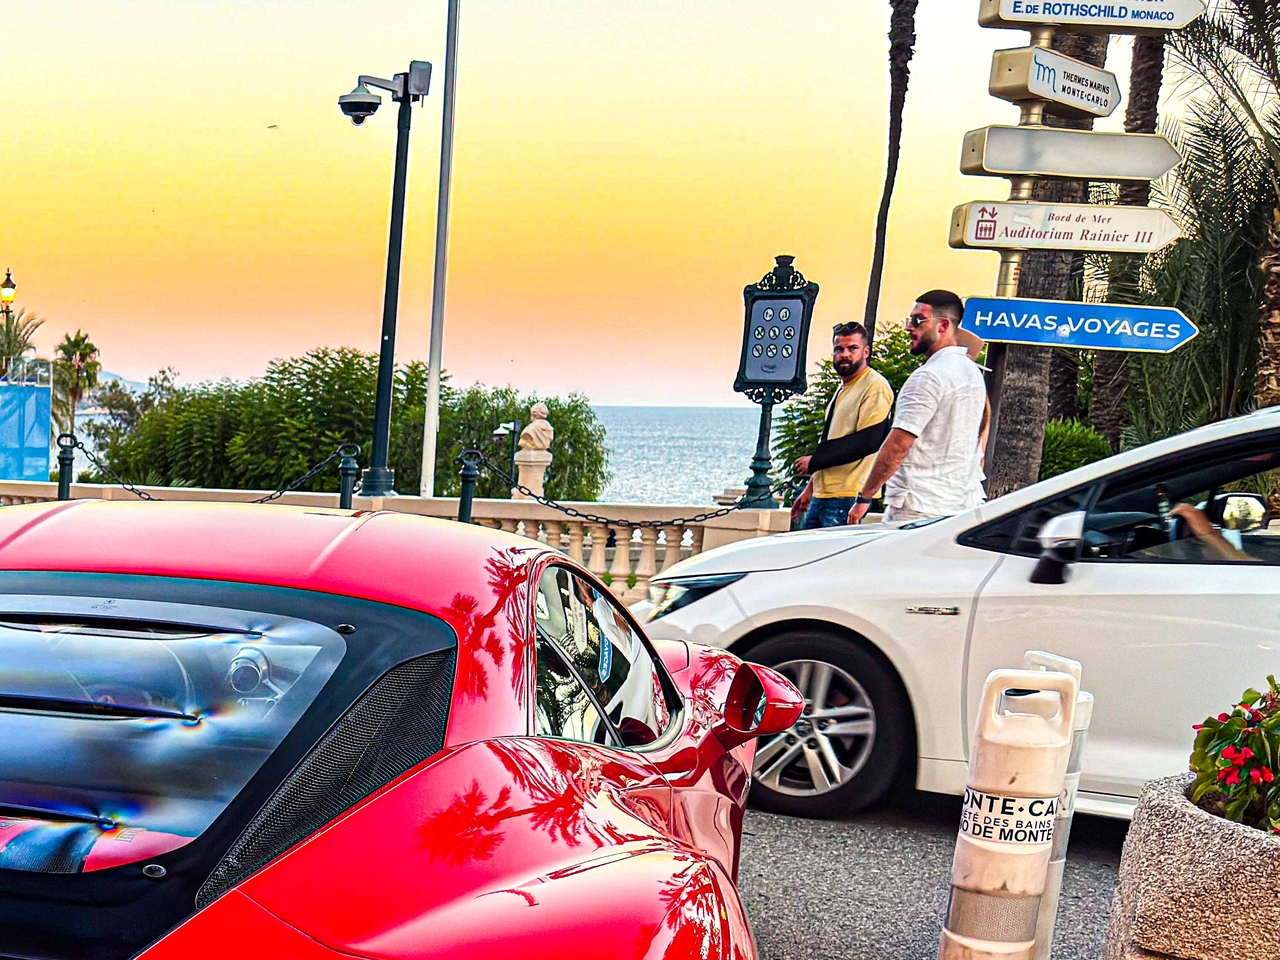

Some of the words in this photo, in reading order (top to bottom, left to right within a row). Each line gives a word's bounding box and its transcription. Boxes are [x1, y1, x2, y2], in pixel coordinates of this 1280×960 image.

[1025, 4, 1039, 14] DE
[1042, 3, 1128, 19] ROTHSCHILD
[1131, 10, 1175, 21] MONACO
[1063, 71, 1089, 88] THERMES
[1089, 81, 1110, 95] MARINS
[1047, 212, 1072, 223] Bord
[1075, 213, 1086, 223] de
[1092, 214, 1112, 224] Mer
[998, 226, 1074, 240] Auditorium
[1080, 229, 1129, 243] Rainier
[1134, 231, 1154, 244] III
[974, 310, 1058, 331] HAVAS
[1066, 316, 1181, 339] VOYAGES
[972, 822, 994, 839] DE
[983, 816, 1010, 828] DES
[1015, 819, 1051, 829] BAINS
